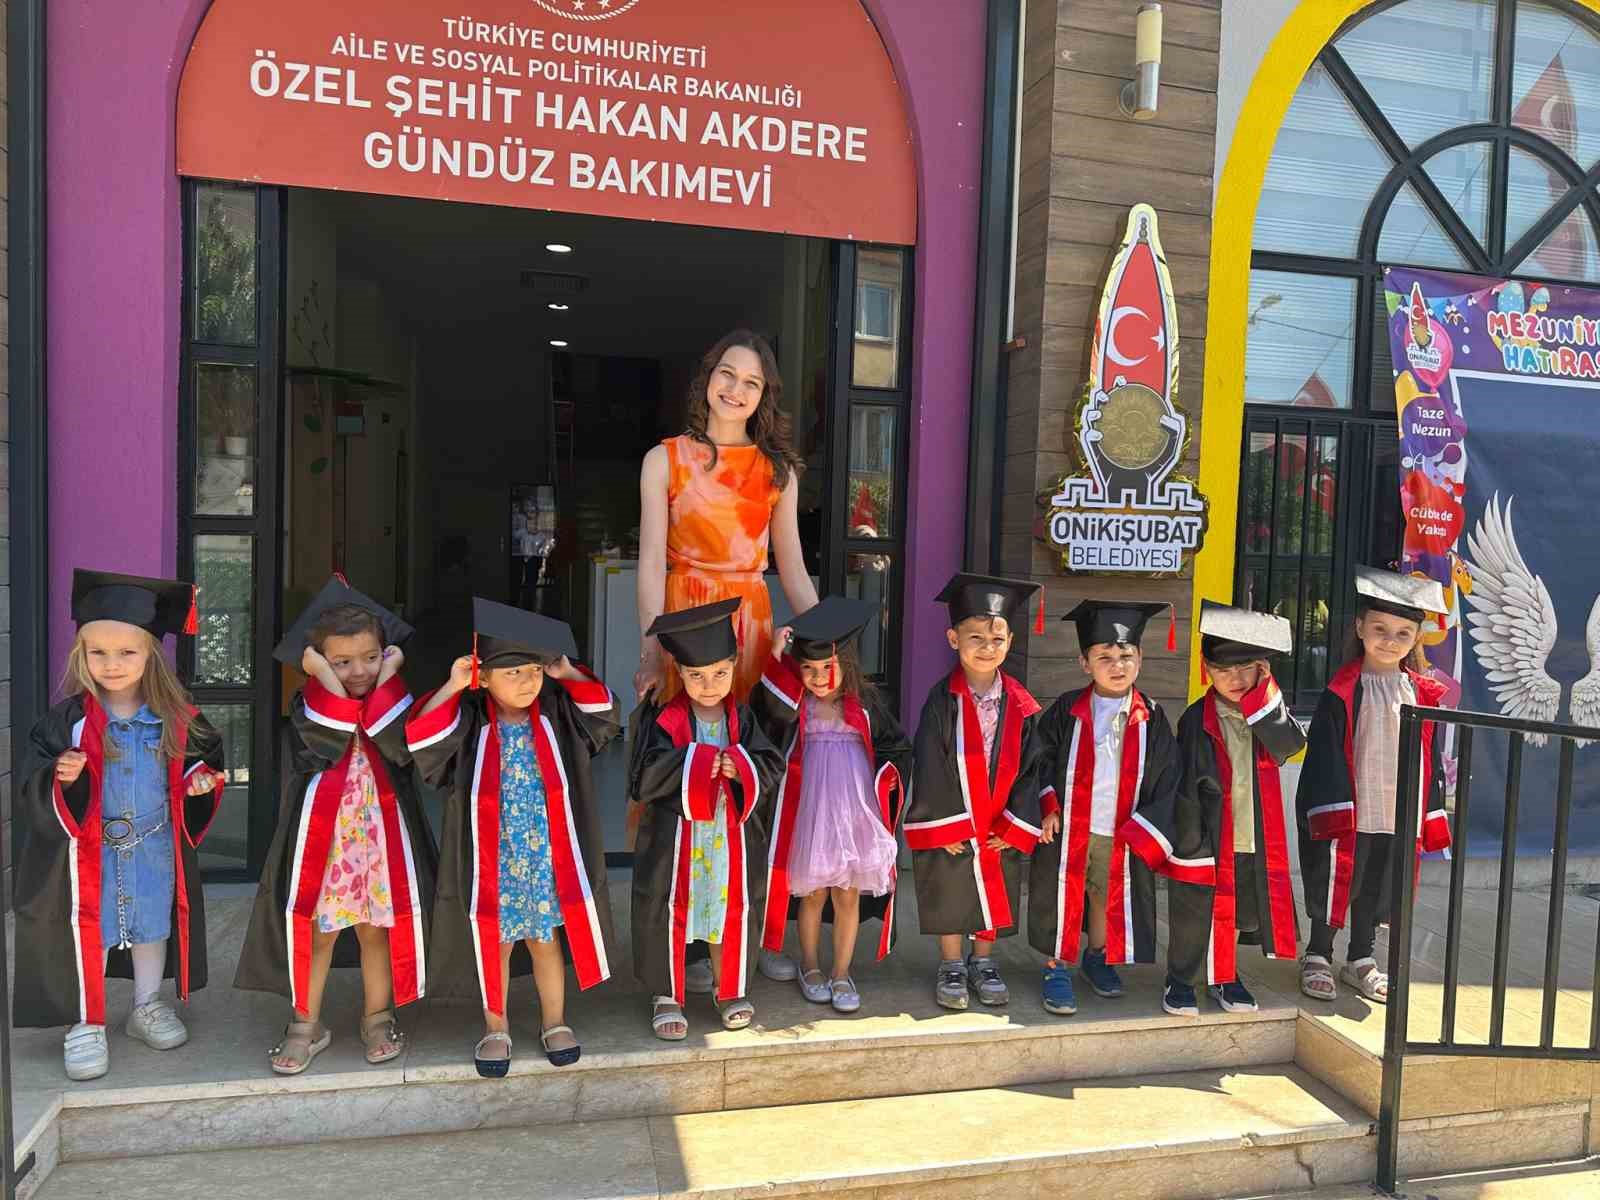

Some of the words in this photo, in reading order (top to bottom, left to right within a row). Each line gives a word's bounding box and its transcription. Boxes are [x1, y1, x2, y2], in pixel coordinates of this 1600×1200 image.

[331, 32, 388, 61] AİLE
[394, 42, 425, 65] VE
[431, 47, 522, 77] SOSYAL
[528, 59, 678, 95] POLİTİKALAR
[684, 76, 802, 109] BAKANLIĞI
[442, 15, 545, 50] TÜRKİYE
[551, 30, 706, 69] CUMHURİYETİ
[250, 49, 372, 109] ÖZEL
[384, 74, 522, 124] ŞEHİT
[535, 91, 688, 143] HAKAN
[699, 111, 868, 163] AKDERE
[364, 125, 555, 186] GÜNDÜZ
[569, 152, 772, 208] BAKIMEVİ
[1487, 310, 1600, 347] MEZUNİY
[1416, 405, 1445, 420] Taze
